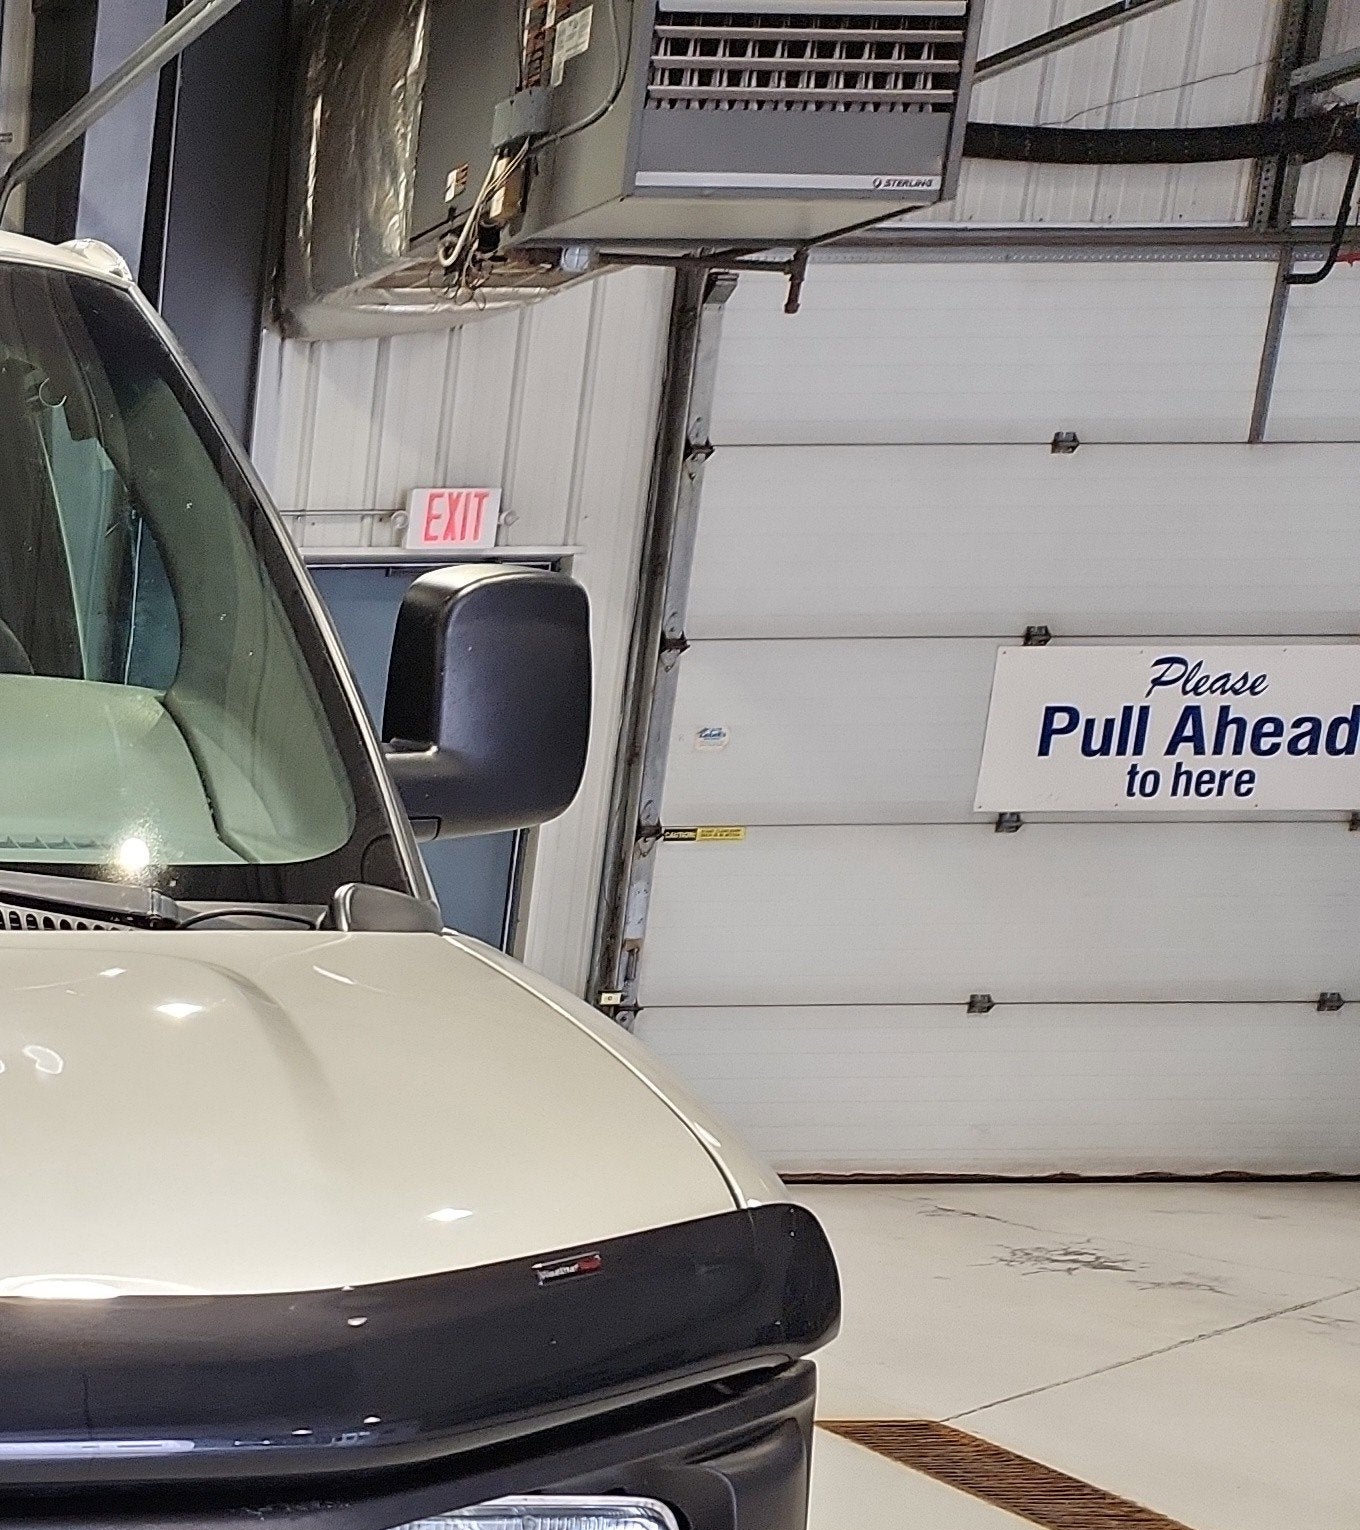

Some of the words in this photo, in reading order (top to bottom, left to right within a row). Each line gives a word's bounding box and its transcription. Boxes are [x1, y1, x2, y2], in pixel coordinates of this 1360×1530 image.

[883, 178, 934, 188] STERLING
[423, 491, 490, 542] EXIT
[1144, 655, 1270, 699] Please
[1036, 704, 1151, 758] Pull
[1163, 704, 1360, 757] Ahead
[1125, 762, 1161, 798] to
[1169, 761, 1257, 798] here
